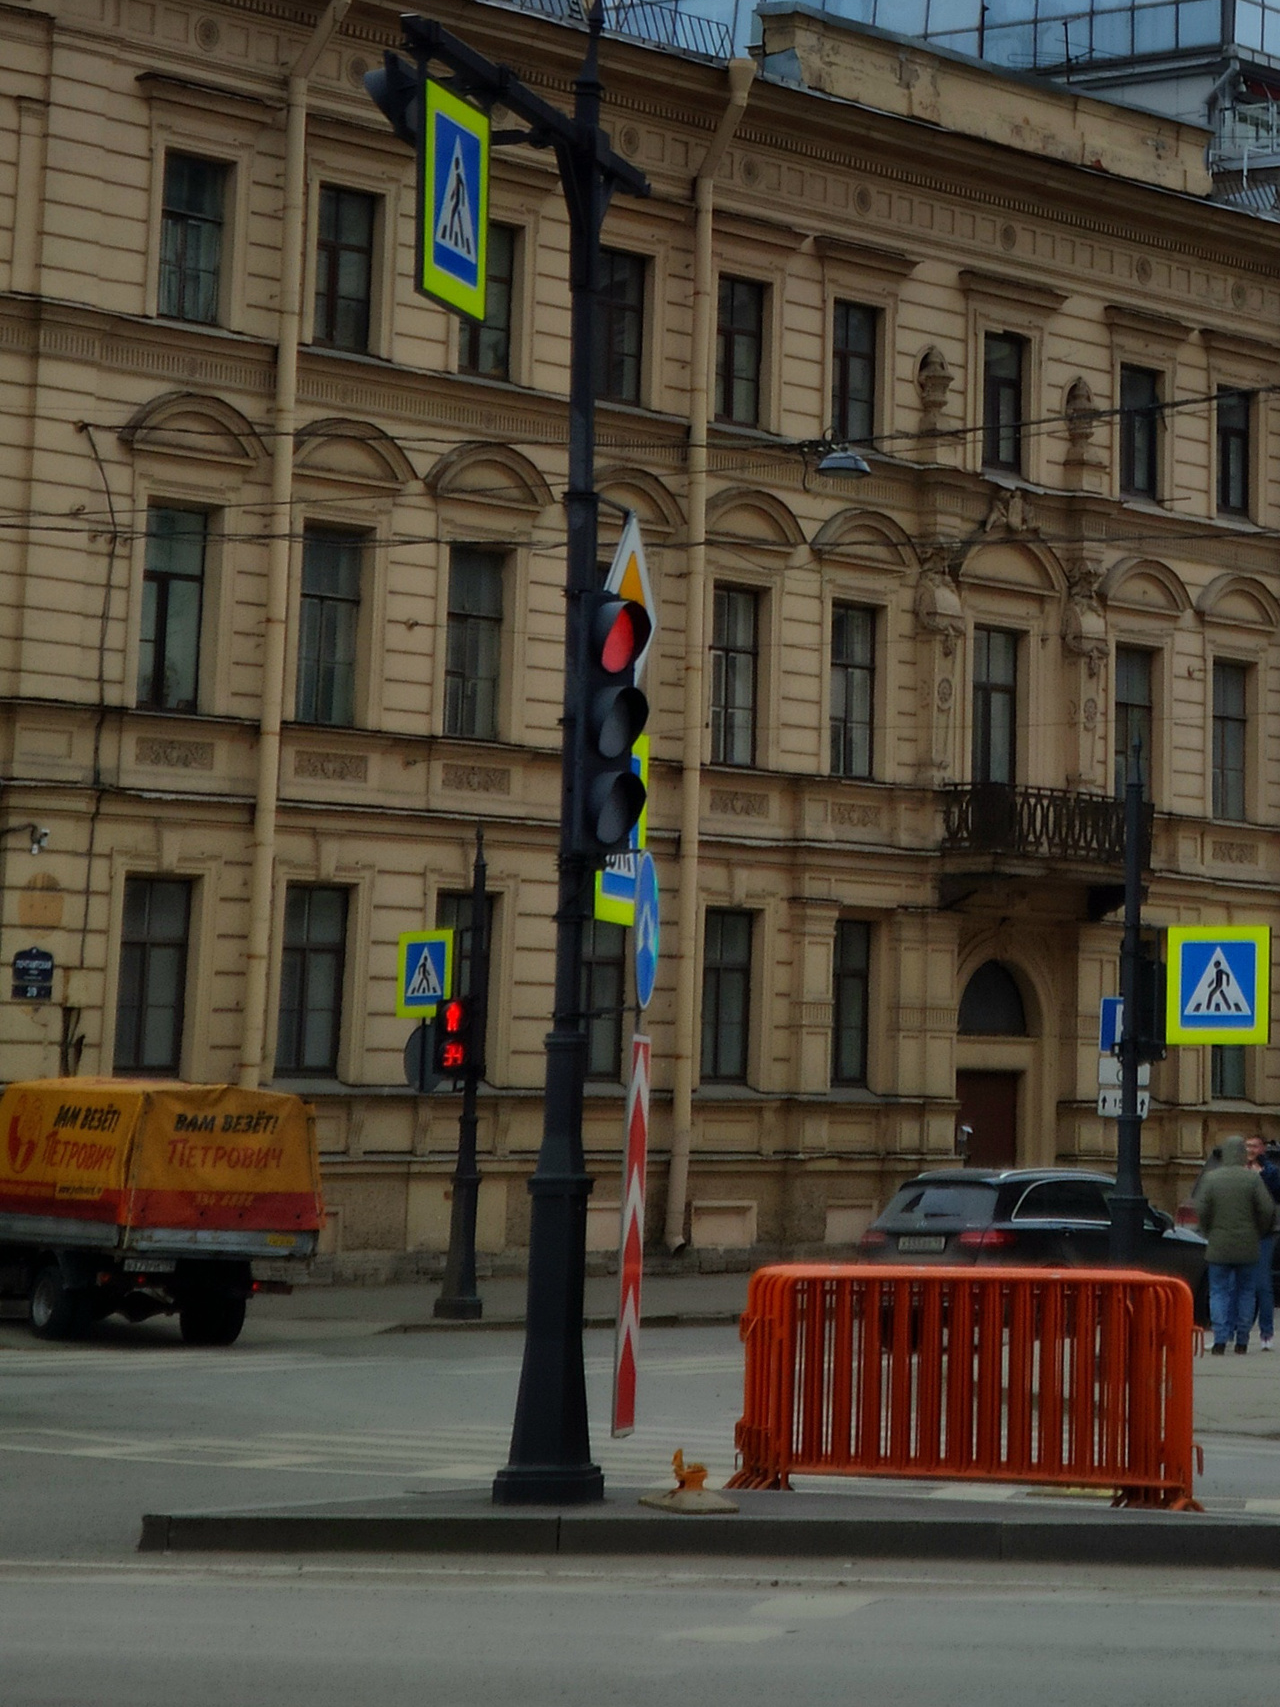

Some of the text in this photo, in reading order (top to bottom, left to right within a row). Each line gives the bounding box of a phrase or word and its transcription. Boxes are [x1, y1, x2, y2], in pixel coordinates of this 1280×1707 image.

[80, 1104, 122, 1134] ВЕЗЁТ!
[174, 1111, 280, 1134] ВАМ ВЕЗЁТ!
